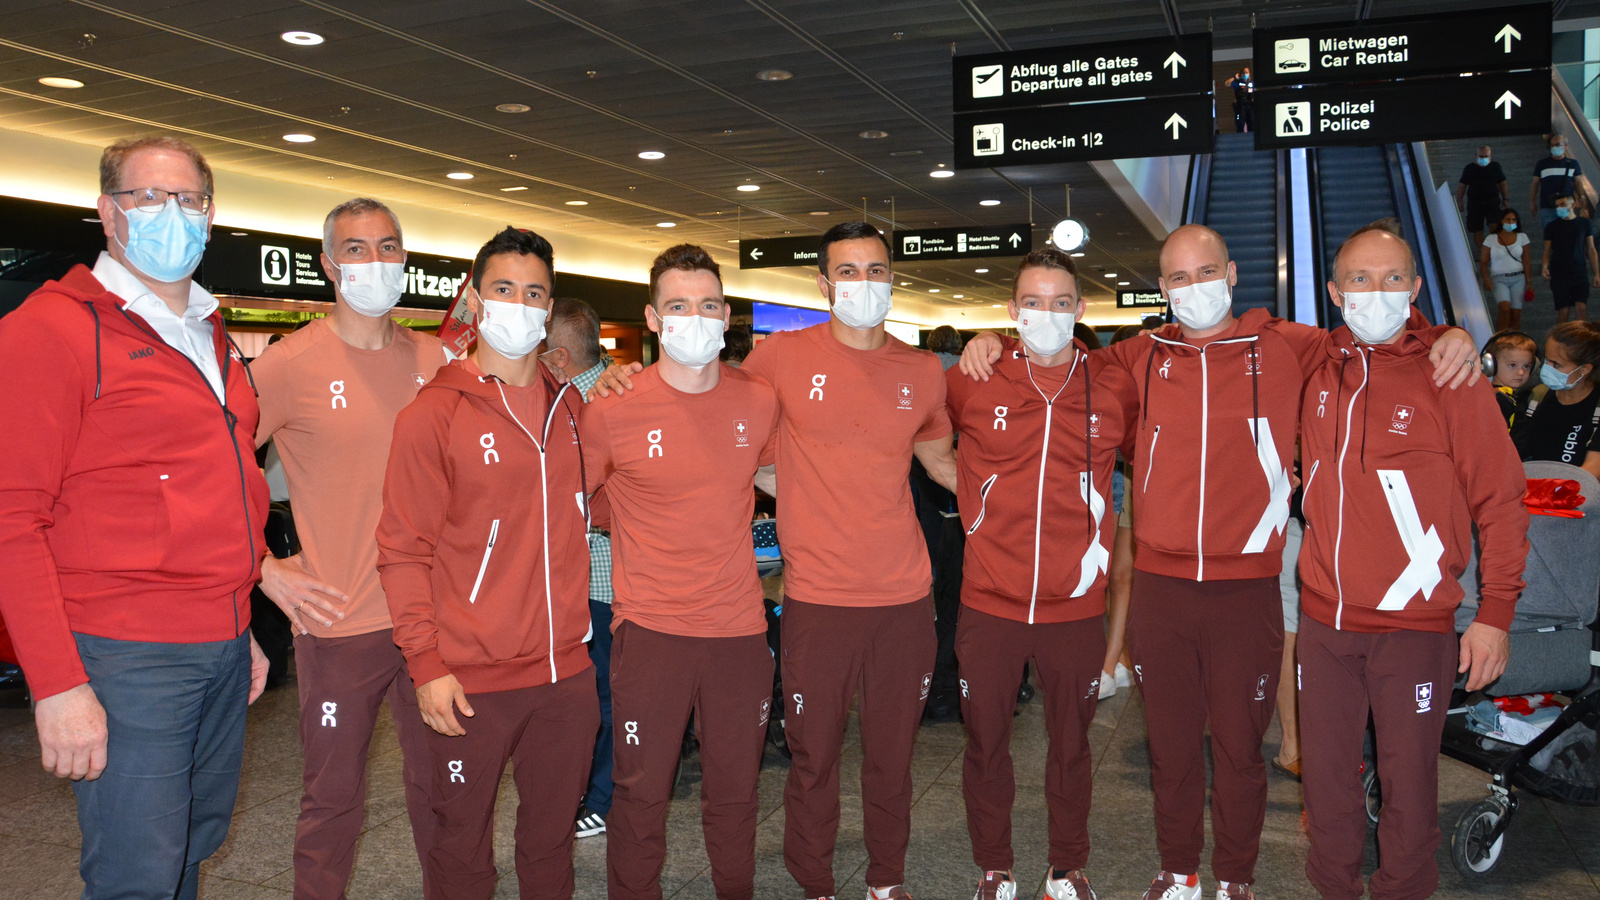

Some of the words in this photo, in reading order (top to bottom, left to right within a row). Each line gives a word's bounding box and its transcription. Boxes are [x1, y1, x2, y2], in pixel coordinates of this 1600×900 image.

[1319, 35, 1408, 52] Mietwagen
[1320, 54, 1349, 68] Car
[1355, 48, 1408, 65] Rental
[1010, 63, 1058, 78] Abflug
[1062, 59, 1090, 74] alle
[1094, 56, 1139, 71] Gates
[1011, 76, 1083, 93] Departure
[1087, 72, 1106, 86] all
[1110, 70, 1153, 87] gates
[1320, 99, 1375, 116] Polizei
[1320, 117, 1370, 132] Police
[1011, 135, 1076, 151] Check-in
[295, 252, 313, 260] Hotels
[793, 251, 818, 259] Inform
[295, 260, 311, 269] Tours
[295, 268, 319, 277] Services
[1561, 424, 1582, 463] Pablo
